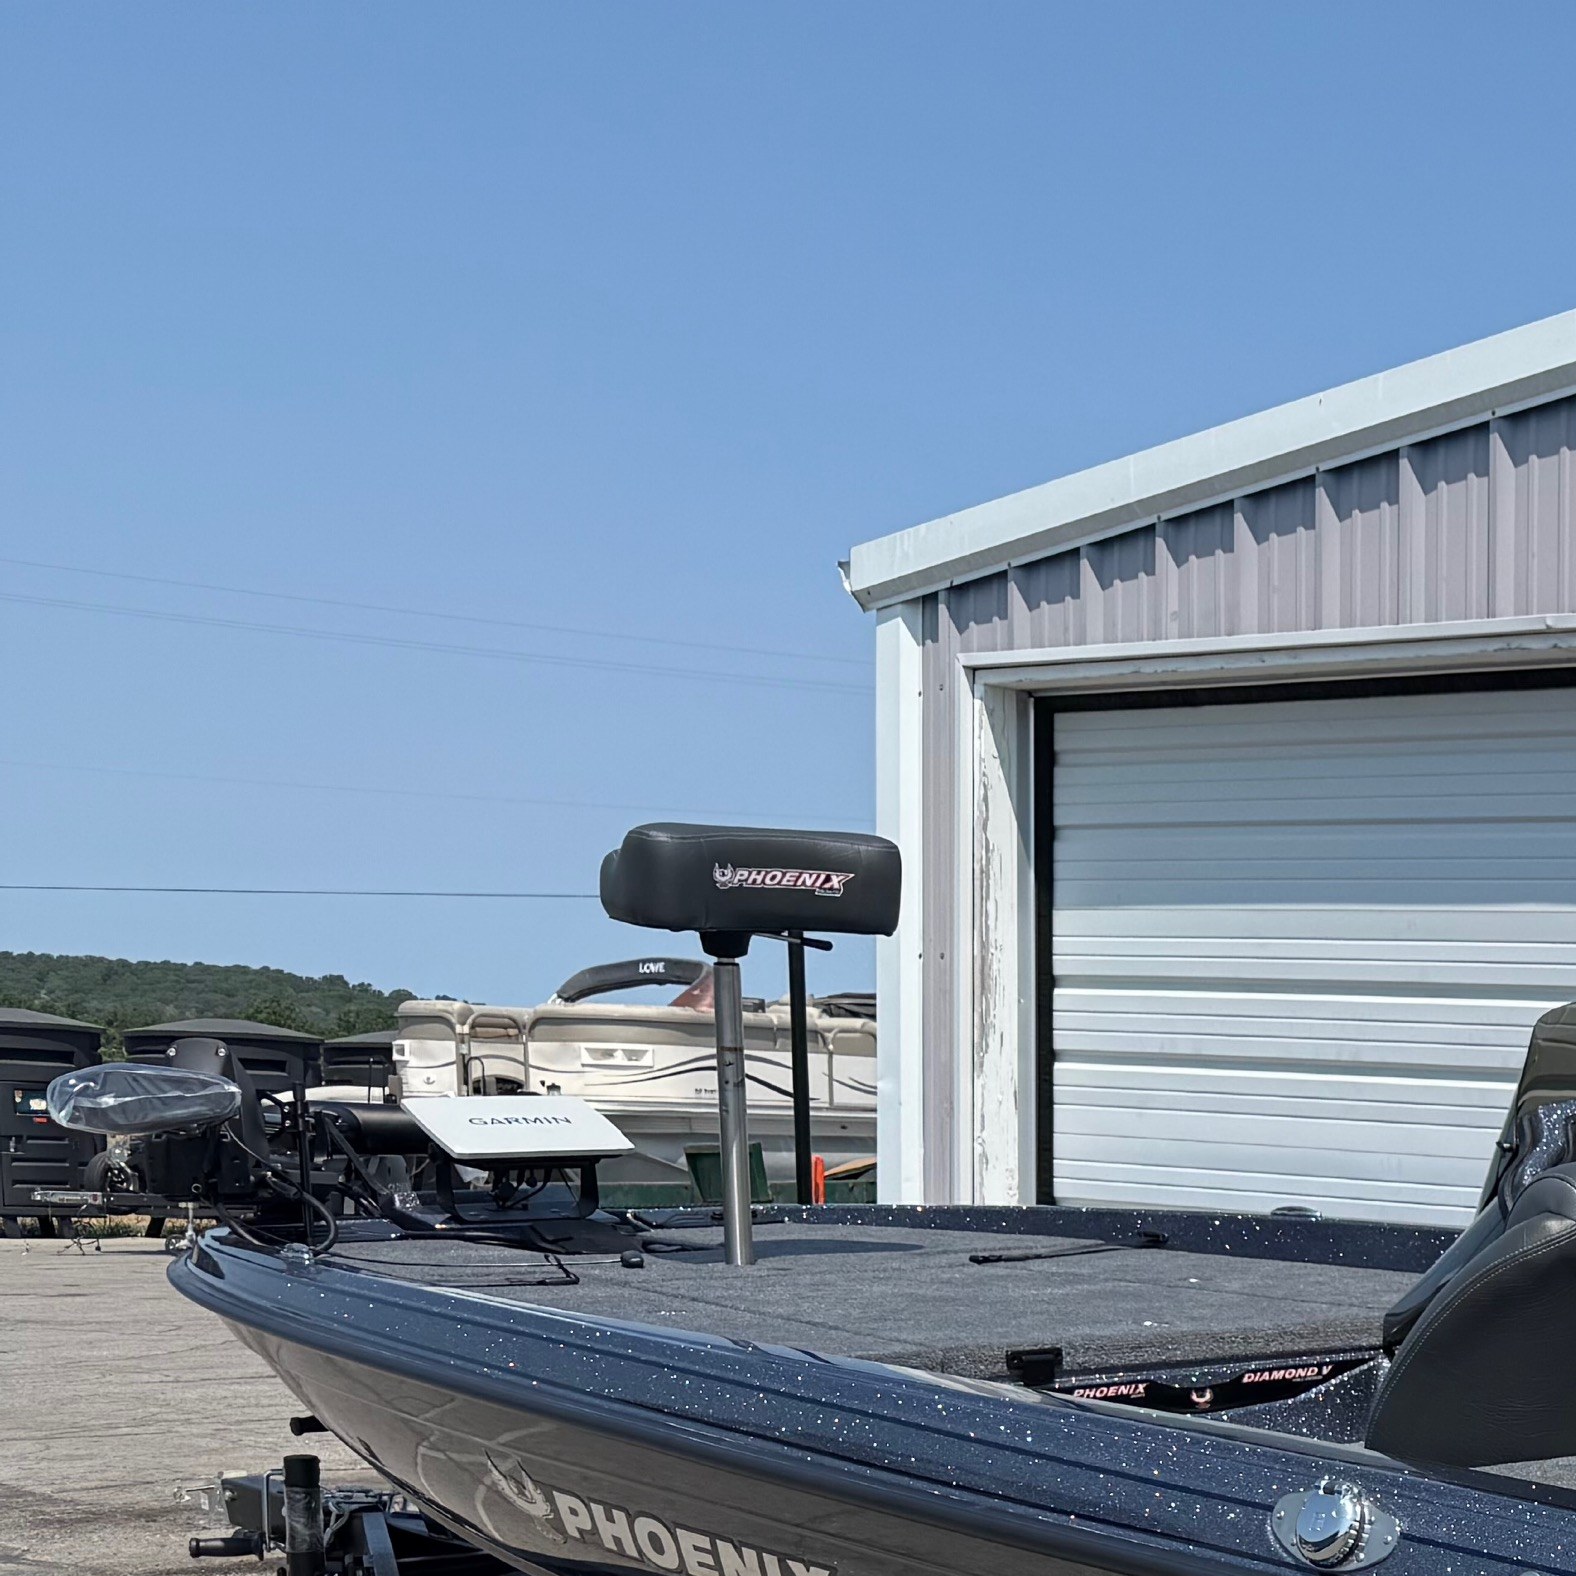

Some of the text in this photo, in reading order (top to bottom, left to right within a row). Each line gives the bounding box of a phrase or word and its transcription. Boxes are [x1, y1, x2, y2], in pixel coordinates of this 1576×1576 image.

[733, 870, 847, 889] PHOENIX
[468, 1116, 572, 1126] GARMIN
[1242, 1366, 1318, 1384] DIAMOND
[1320, 1364, 1334, 1376] V
[1073, 1382, 1149, 1399] PHOENIX
